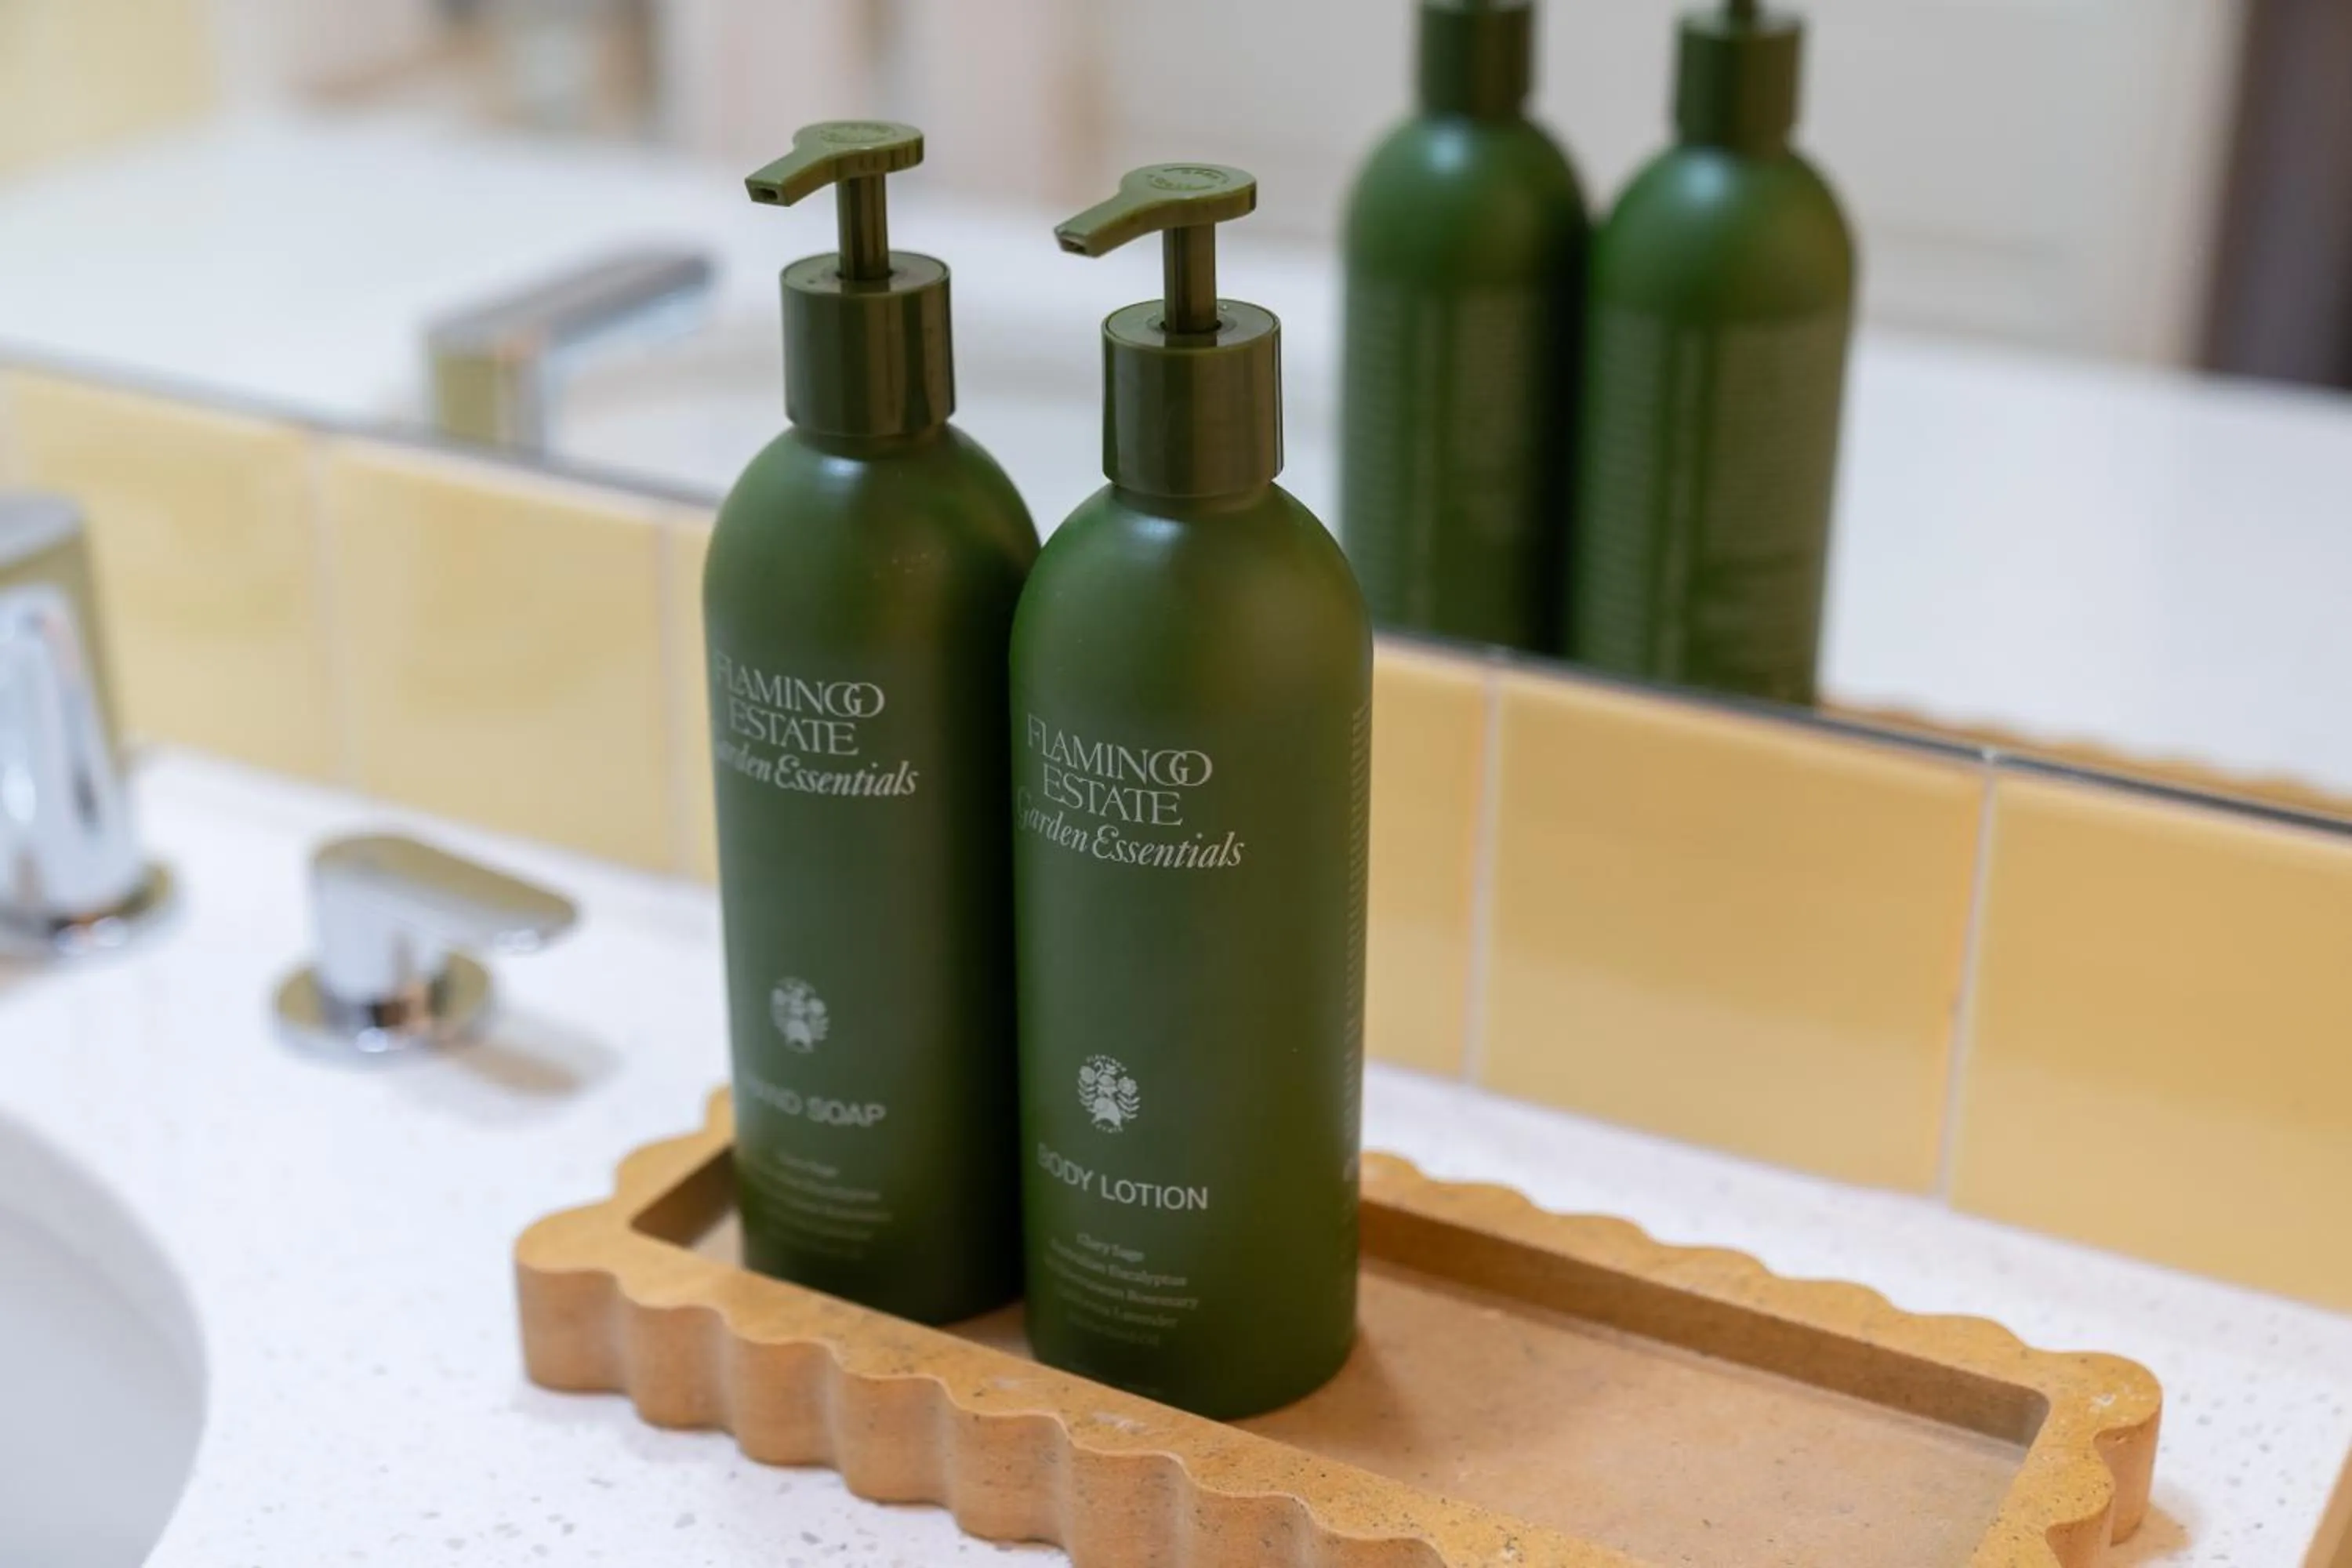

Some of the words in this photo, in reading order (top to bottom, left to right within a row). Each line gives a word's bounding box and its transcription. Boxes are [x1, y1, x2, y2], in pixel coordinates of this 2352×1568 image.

[714, 649, 885, 718] FLAMINGO
[730, 695, 859, 756] ESTATE
[1028, 713, 1213, 786] FLAMINGO
[775, 753, 920, 797] Essentials
[1044, 763, 1183, 826] ESTATE
[1018, 785, 1089, 853] Garden
[1092, 824, 1245, 868] Essentials
[806, 1096, 887, 1128] SOAP
[1037, 1142, 1094, 1192] BODY
[1100, 1174, 1208, 1210] LOTION
